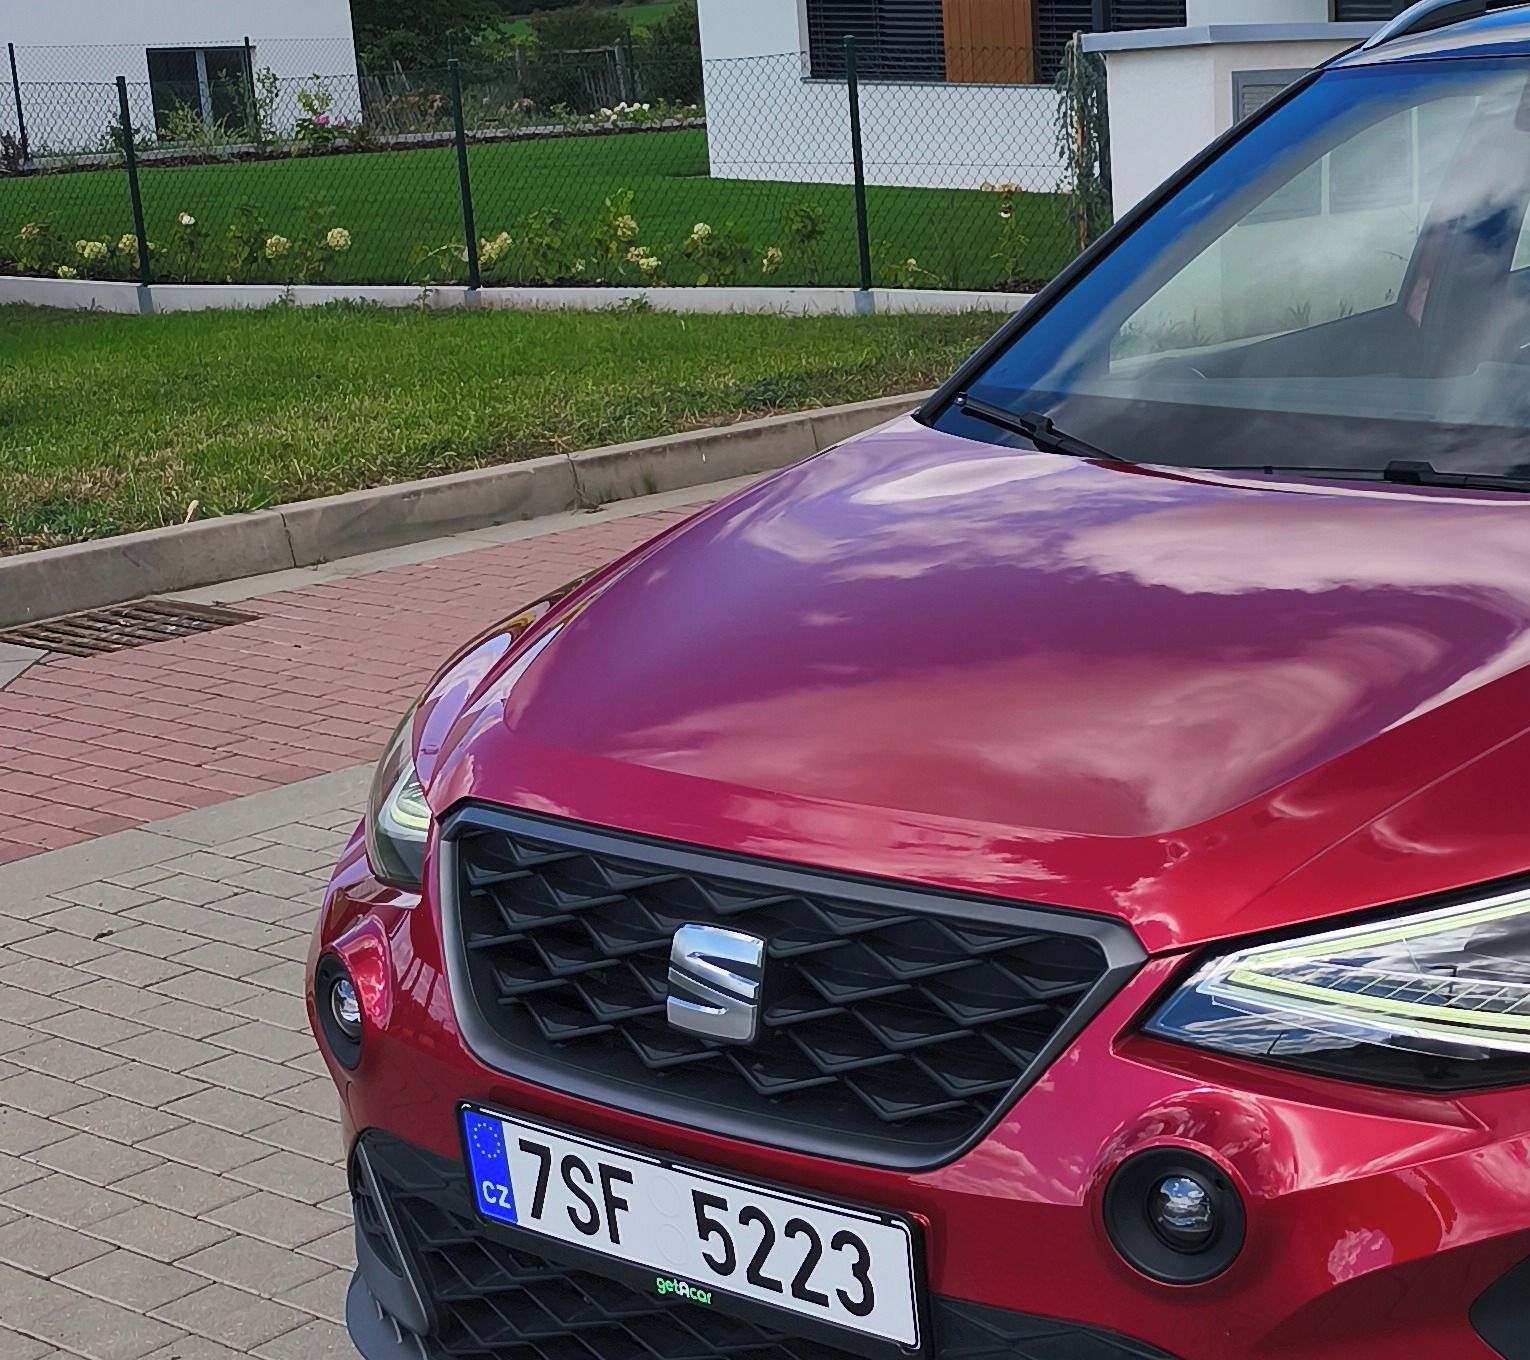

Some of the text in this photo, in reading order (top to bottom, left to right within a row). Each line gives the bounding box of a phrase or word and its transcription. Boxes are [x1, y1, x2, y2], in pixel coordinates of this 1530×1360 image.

[482, 1180, 512, 1209] CZ
[519, 1138, 875, 1317] 7SF 5223
[656, 1277, 712, 1305] getAcar
